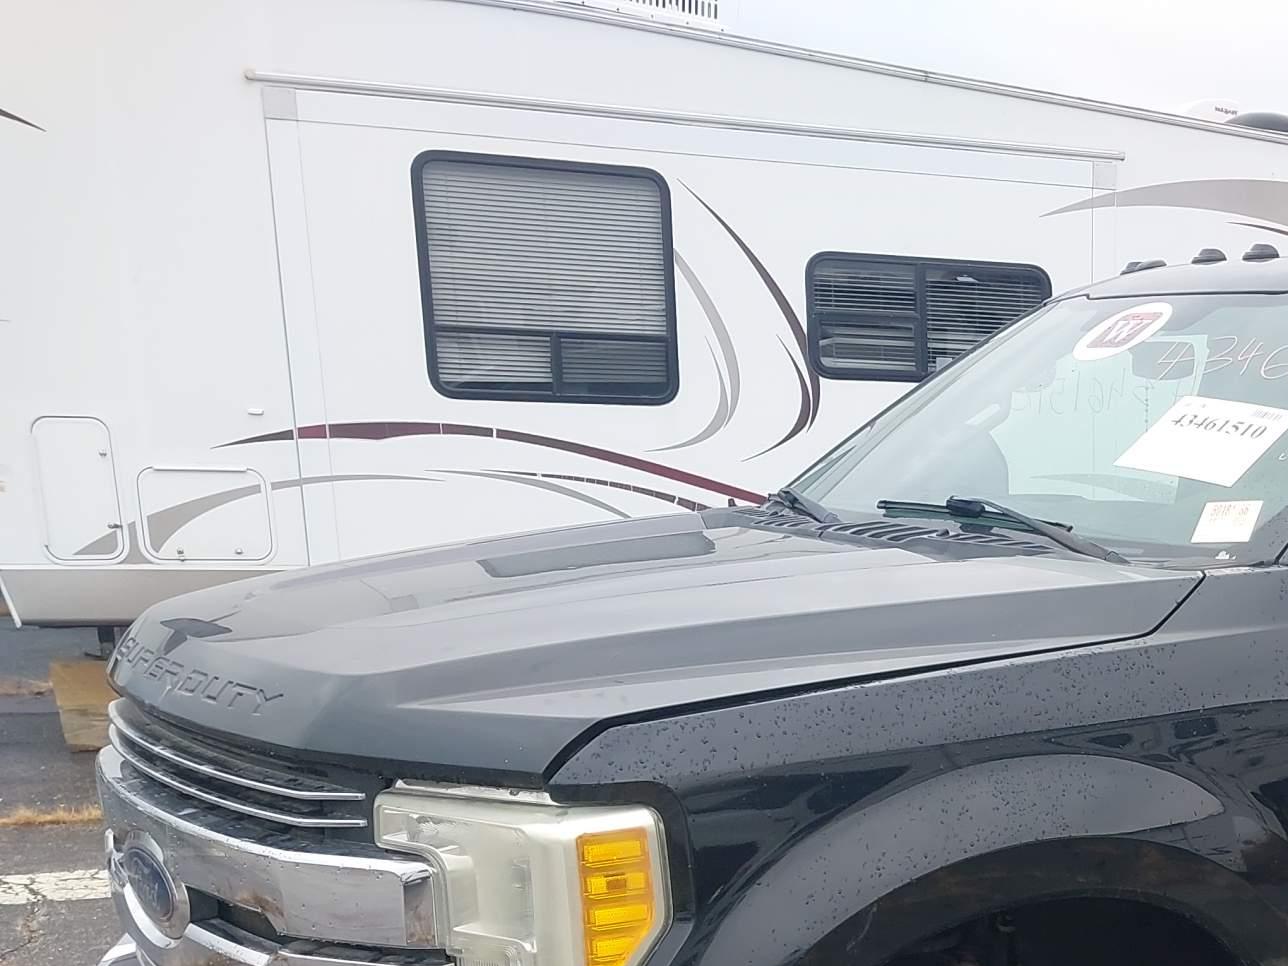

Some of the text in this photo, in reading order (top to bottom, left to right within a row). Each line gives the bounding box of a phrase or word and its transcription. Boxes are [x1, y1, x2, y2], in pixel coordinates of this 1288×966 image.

[1171, 413, 1268, 440] 43461510
[114, 636, 285, 716] SUPER DUTY
